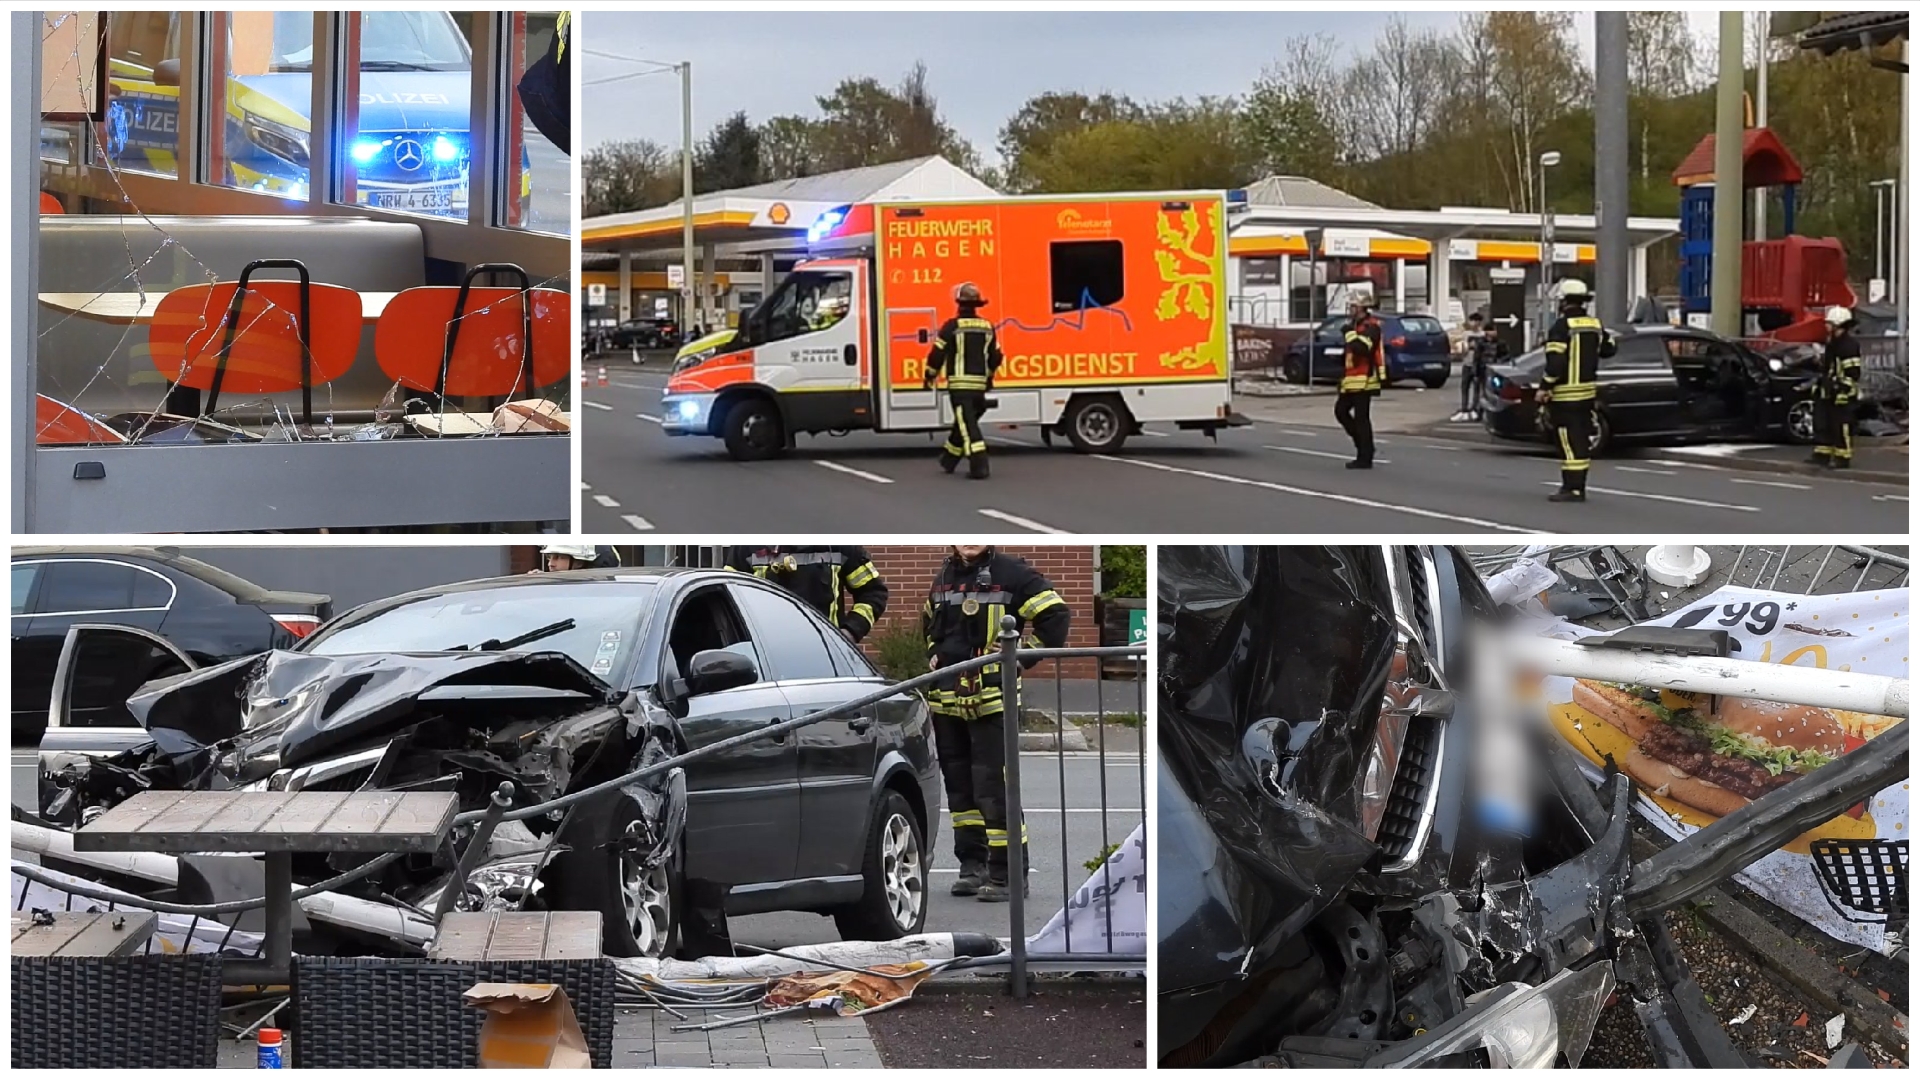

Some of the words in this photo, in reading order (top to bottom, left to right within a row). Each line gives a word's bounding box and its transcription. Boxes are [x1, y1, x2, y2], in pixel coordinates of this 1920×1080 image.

[358, 92, 450, 105] OLIZEI
[122, 107, 180, 133] OLIZEI
[889, 219, 993, 238] FEUERWEHR
[889, 239, 995, 259] HAGEN
[913, 267, 942, 284] 112
[902, 352, 1138, 380] RNGSDIENST
